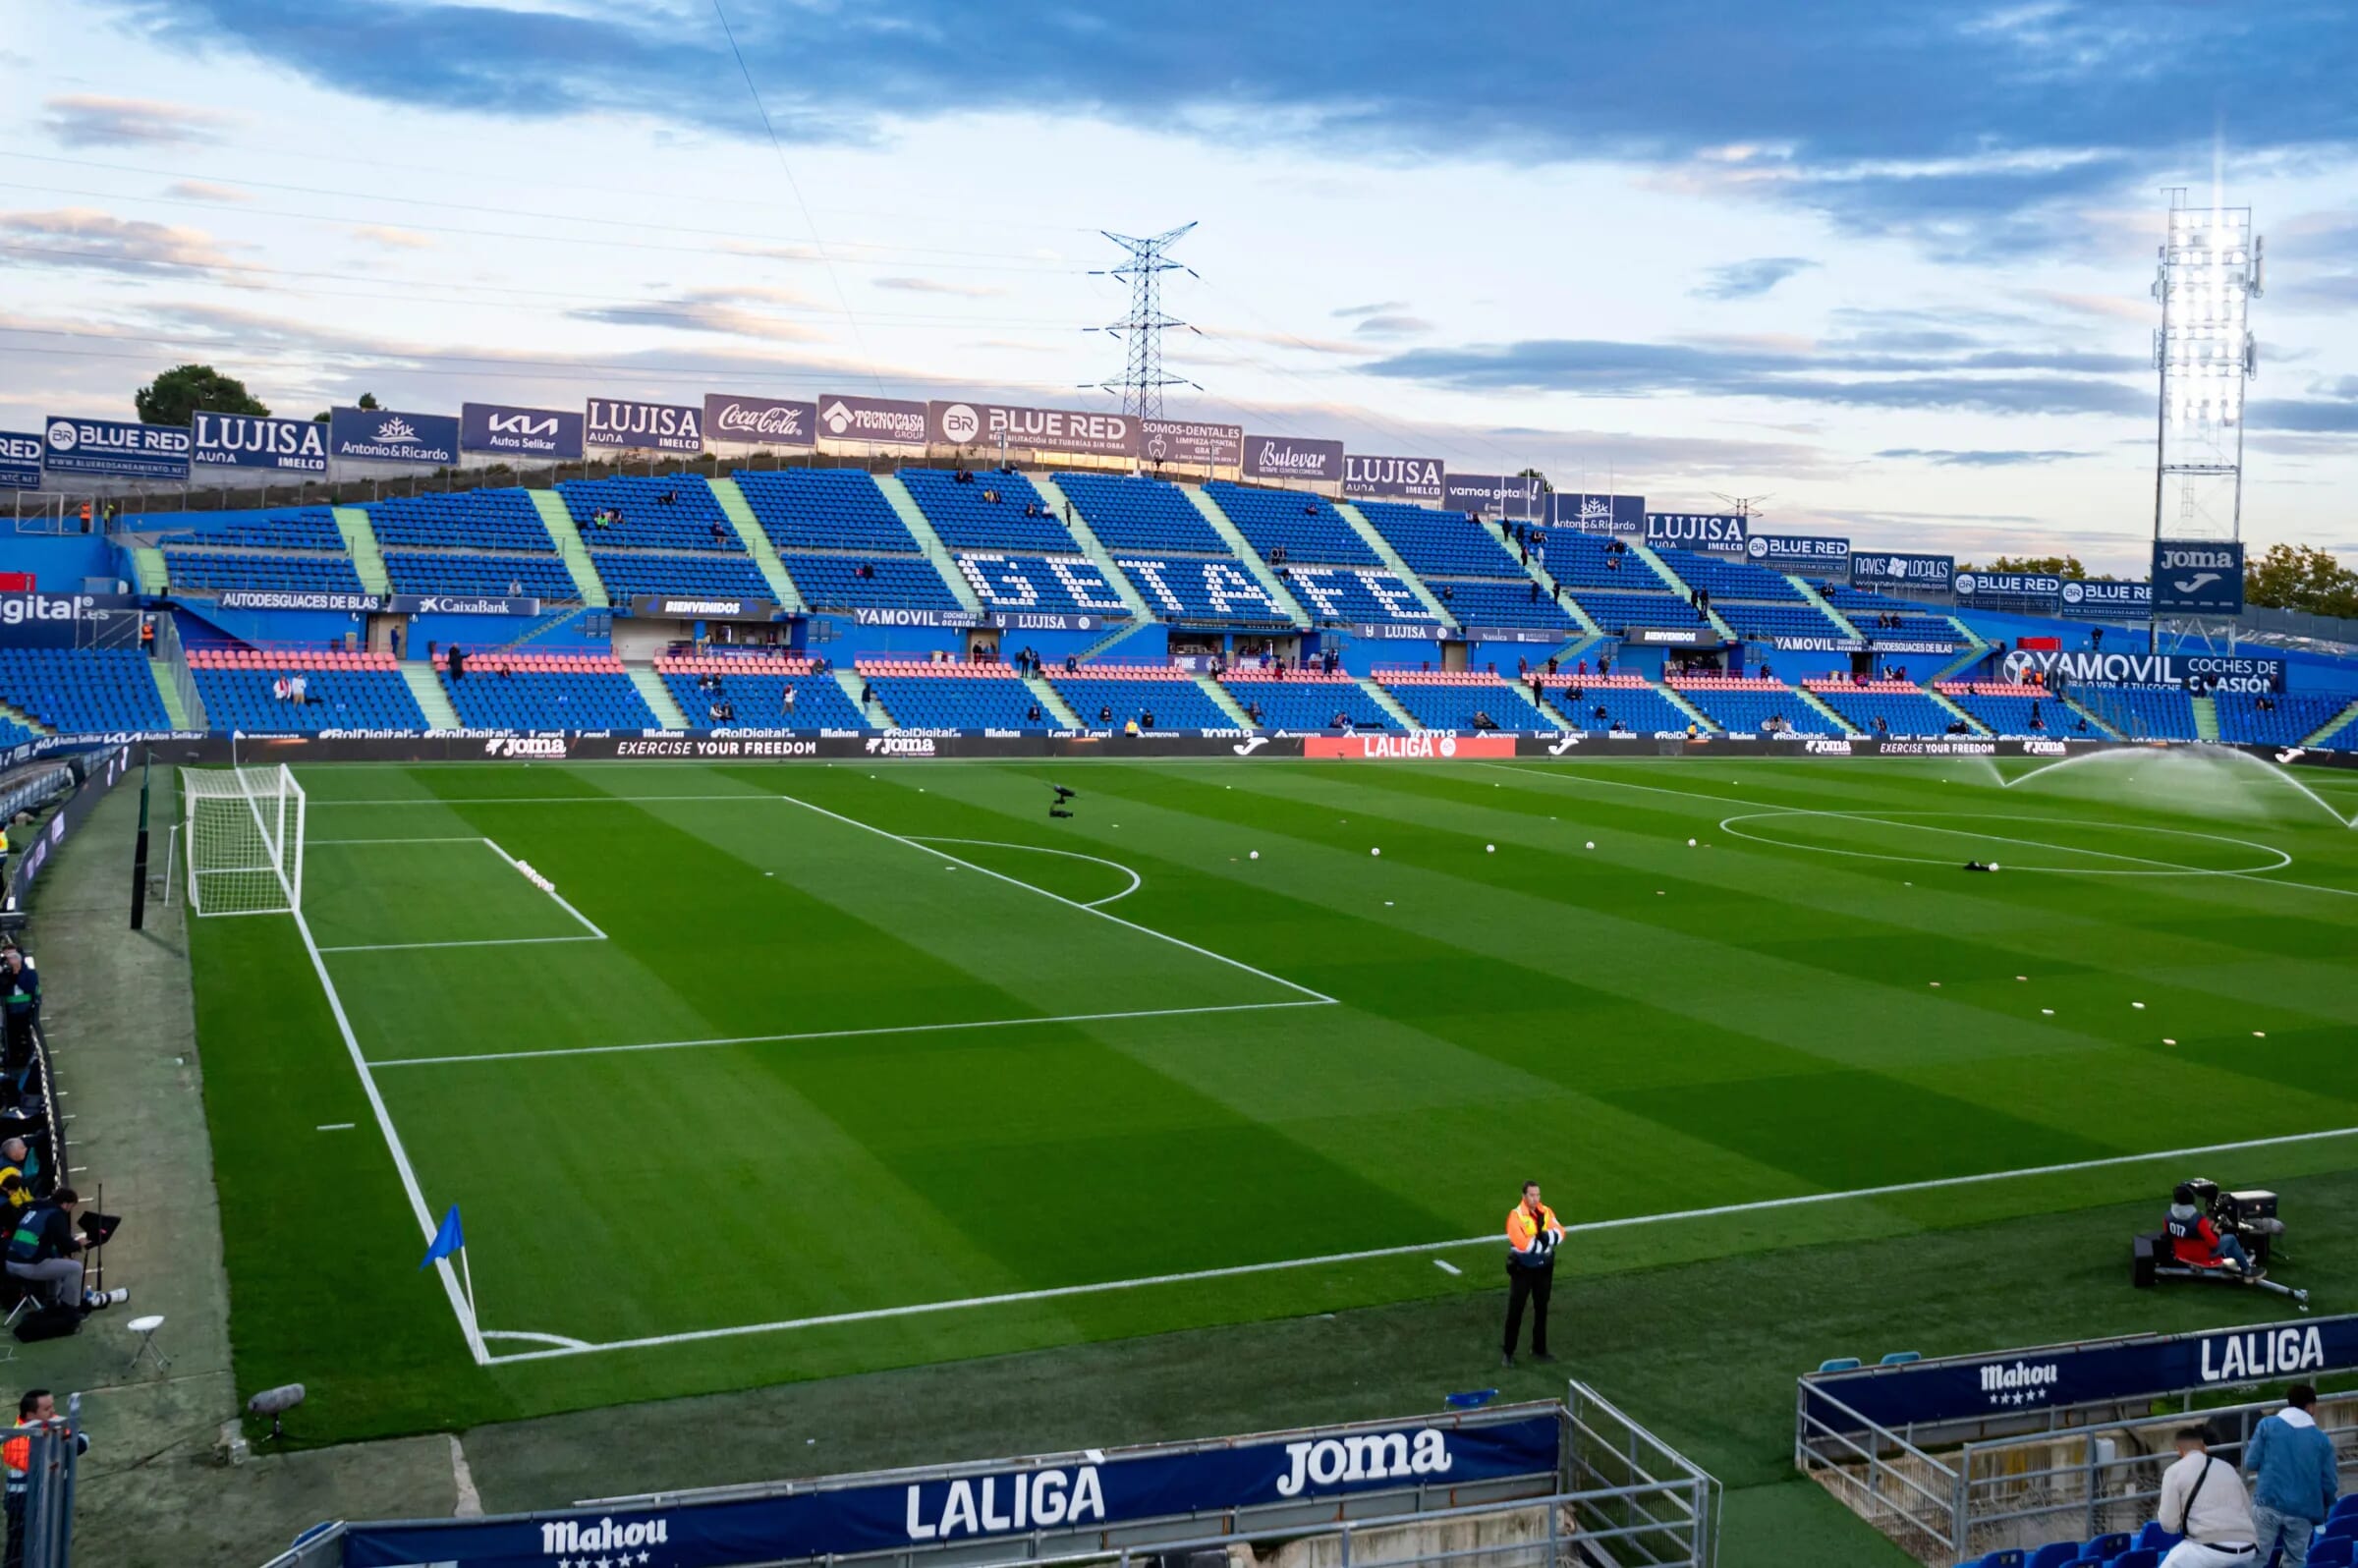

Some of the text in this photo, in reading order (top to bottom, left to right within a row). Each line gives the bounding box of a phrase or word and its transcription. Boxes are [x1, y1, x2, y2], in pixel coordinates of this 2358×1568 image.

[489, 413, 558, 436] KIA
[590, 402, 700, 437] LUJISA
[718, 403, 799, 435] Coca-Cola
[855, 411, 924, 432] TECNOCASA
[988, 409, 1126, 440] BLUE RED
[80, 424, 190, 451] BLUE RED
[196, 416, 325, 456] LUJISA
[894, 430, 924, 440] GROUP
[1143, 422, 1240, 438] SOMOS-DENTAL.ES
[489, 435, 556, 450] Autos Selikar
[659, 438, 700, 449] IMELCO
[1059, 438, 1091, 448] TUBERÍAS
[1175, 436, 1208, 446] LIMPIEZA
[1260, 440, 1325, 468] Bulevar
[278, 457, 324, 470] IMELCO
[1346, 458, 1440, 485] LUJISA
[1405, 485, 1440, 495] IMELCO
[1450, 487, 1490, 497] vamos
[1648, 516, 1743, 540] LUJISA
[1708, 542, 1743, 551] IMELCO
[1769, 539, 1847, 554] BLUE RED
[1855, 558, 1886, 576] NAVES
[1908, 559, 1948, 578] LOCALES
[957, 552, 1436, 619] GETAFE
[1977, 576, 2058, 591] BLUE RED
[2085, 586, 2128, 599] BLUE
[0, 594, 81, 624] gital
[222, 593, 377, 609] AUTODESGUACES DE BLAS
[440, 597, 509, 613] CaixaBank
[665, 601, 741, 613] BIENVENIDOS
[857, 609, 938, 626] YAMOVIL
[1018, 615, 1066, 629] LUJISA
[1385, 625, 1427, 639] LUJISA
[1645, 631, 1696, 642] BIENVENIDOS
[1775, 637, 1834, 650] YAMOVIL
[1926, 643, 1935, 652] DE
[2036, 652, 2278, 683] YAMOVIL COCHES DE
[617, 741, 815, 755] EXERCISE YOUR FREEDOM
[1364, 737, 1433, 756] LALIGA
[1881, 743, 1994, 754] EXERCISE YOUR FREEDOM
[2201, 1326, 2325, 1381] LALIGA
[1981, 1361, 2057, 1391] Mahou
[906, 1466, 1105, 1540] LALIGA
[542, 1517, 668, 1554] Mahou
